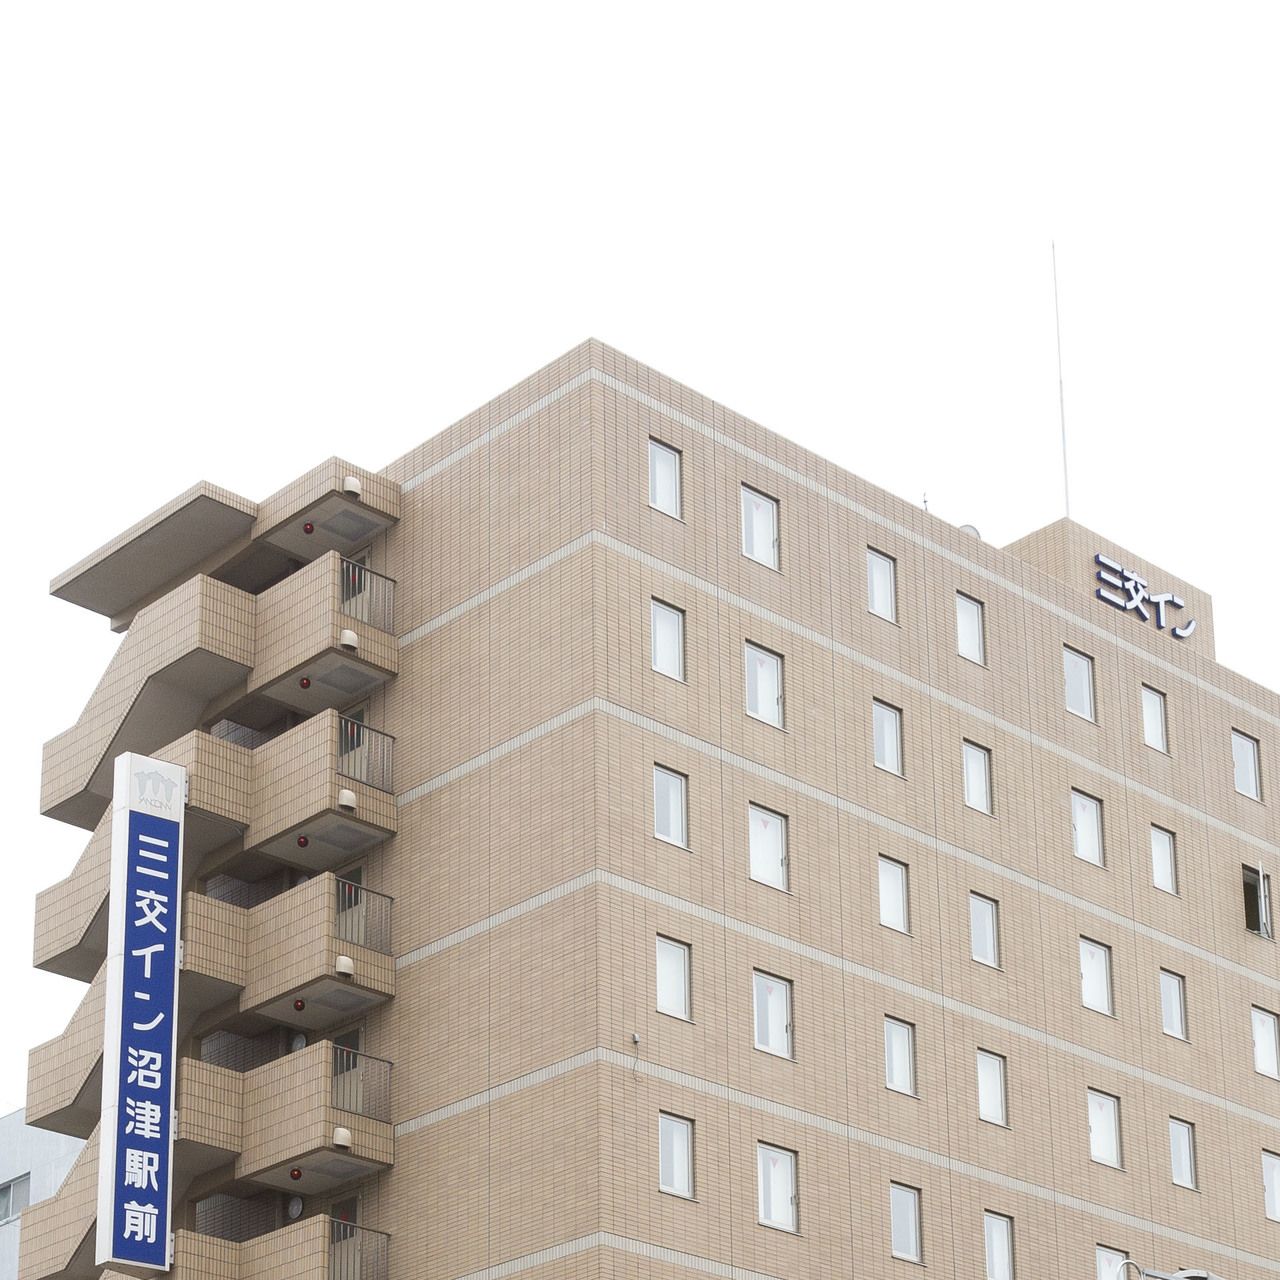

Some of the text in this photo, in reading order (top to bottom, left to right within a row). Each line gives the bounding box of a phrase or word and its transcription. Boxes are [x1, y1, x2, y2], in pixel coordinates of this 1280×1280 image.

[1094, 551, 1197, 640] 三交イン
[122, 832, 169, 1244] 三交イン沼津駅前
